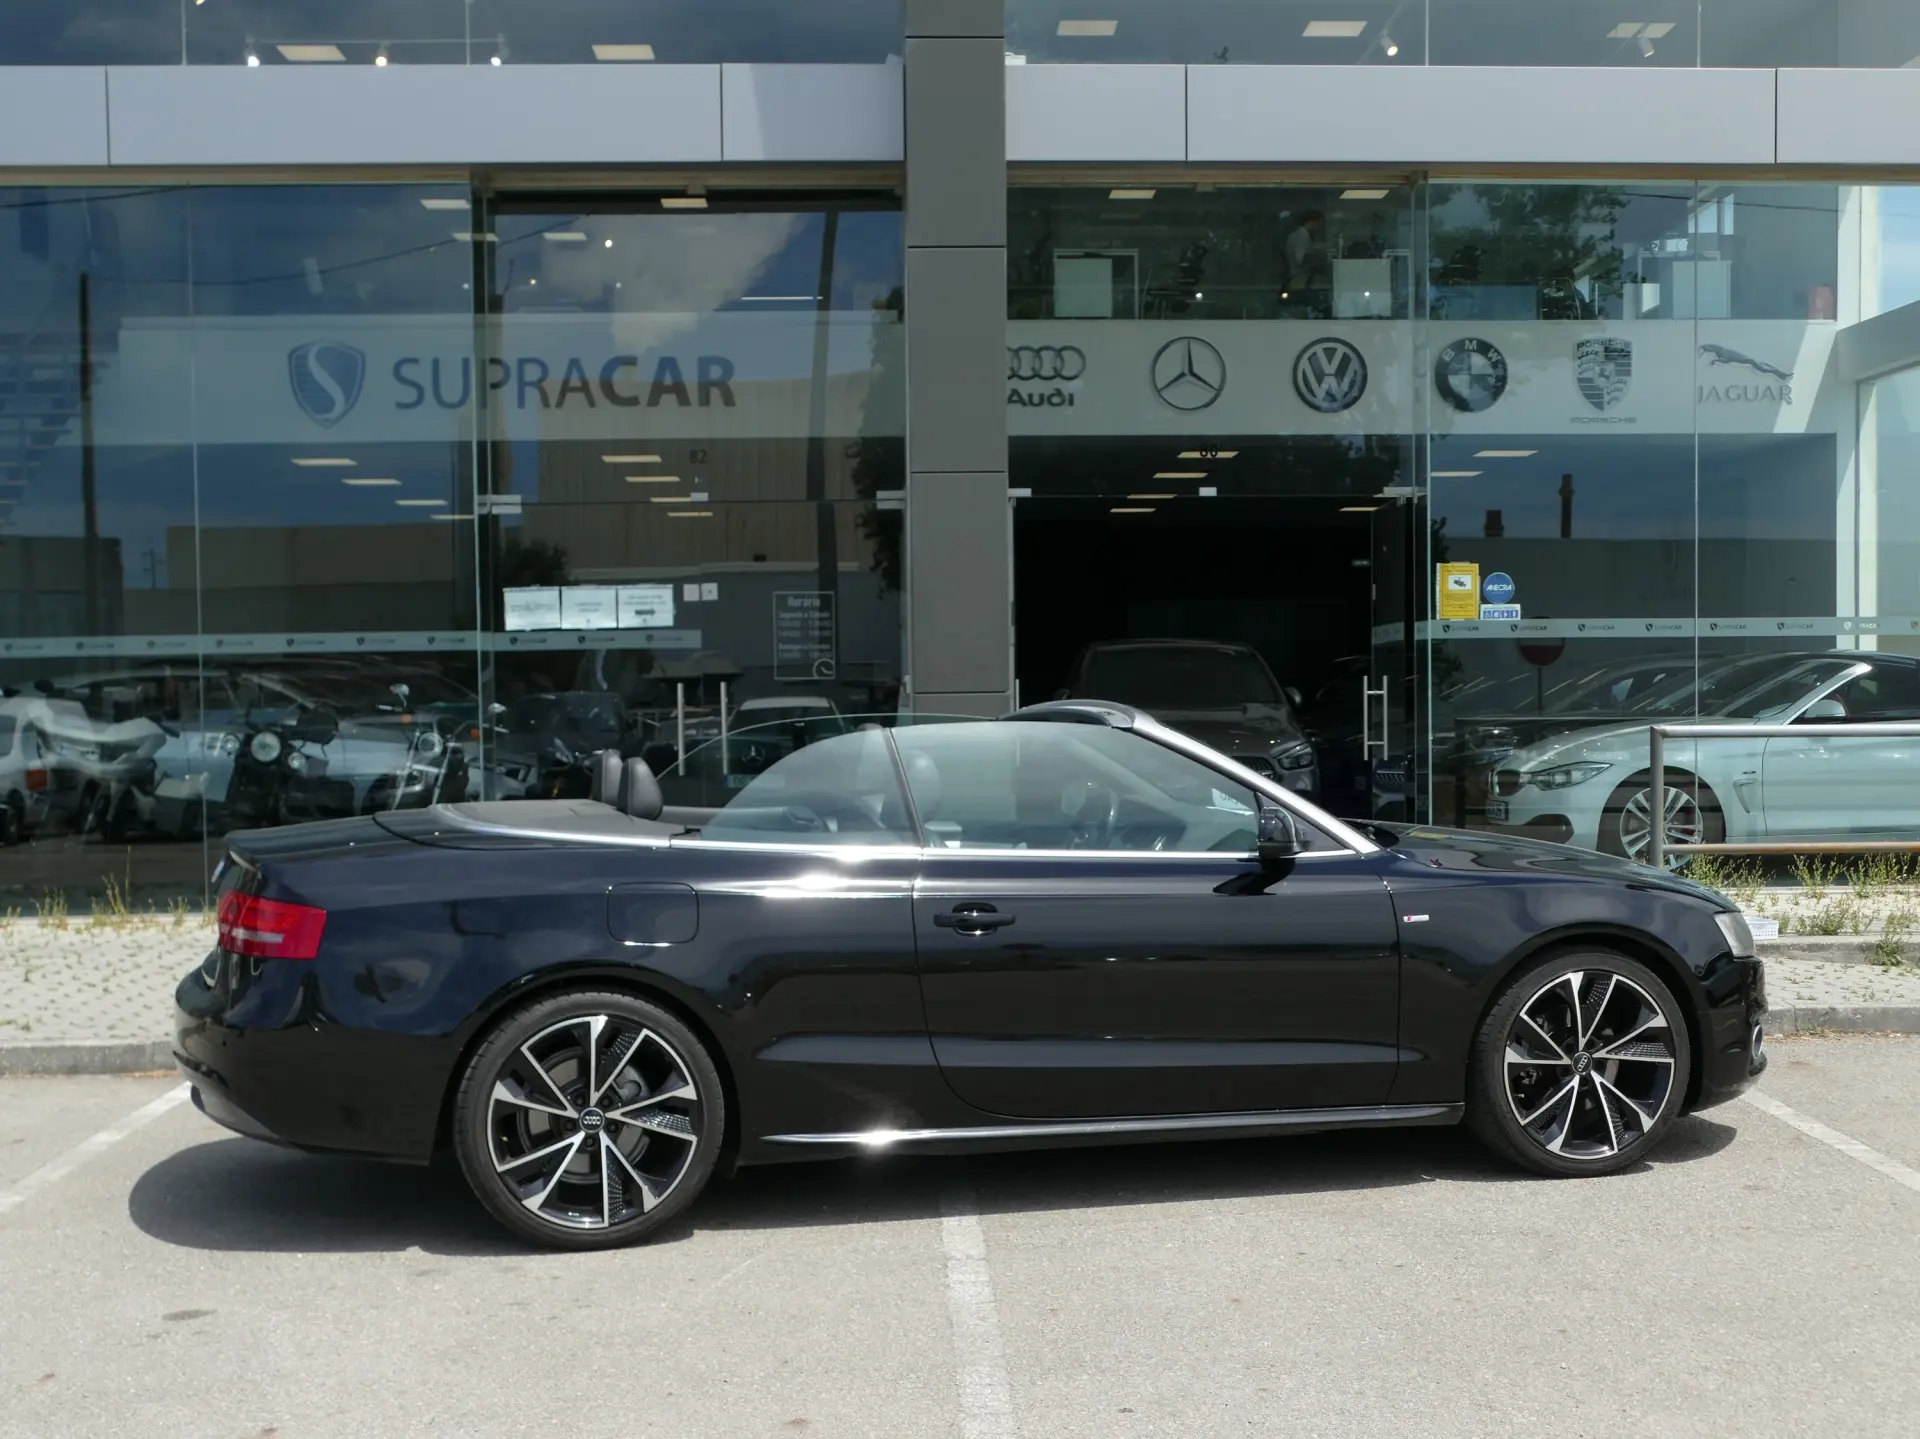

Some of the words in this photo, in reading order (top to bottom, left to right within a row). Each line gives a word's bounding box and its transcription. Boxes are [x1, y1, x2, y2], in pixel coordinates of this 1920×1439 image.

[1442, 339, 1502, 363] BMW
[392, 355, 737, 410] SUPRACAR
[1006, 387, 1075, 408] Audi
[1697, 384, 1794, 406] JAGUAR
[1570, 416, 1638, 424] PORSCHE
